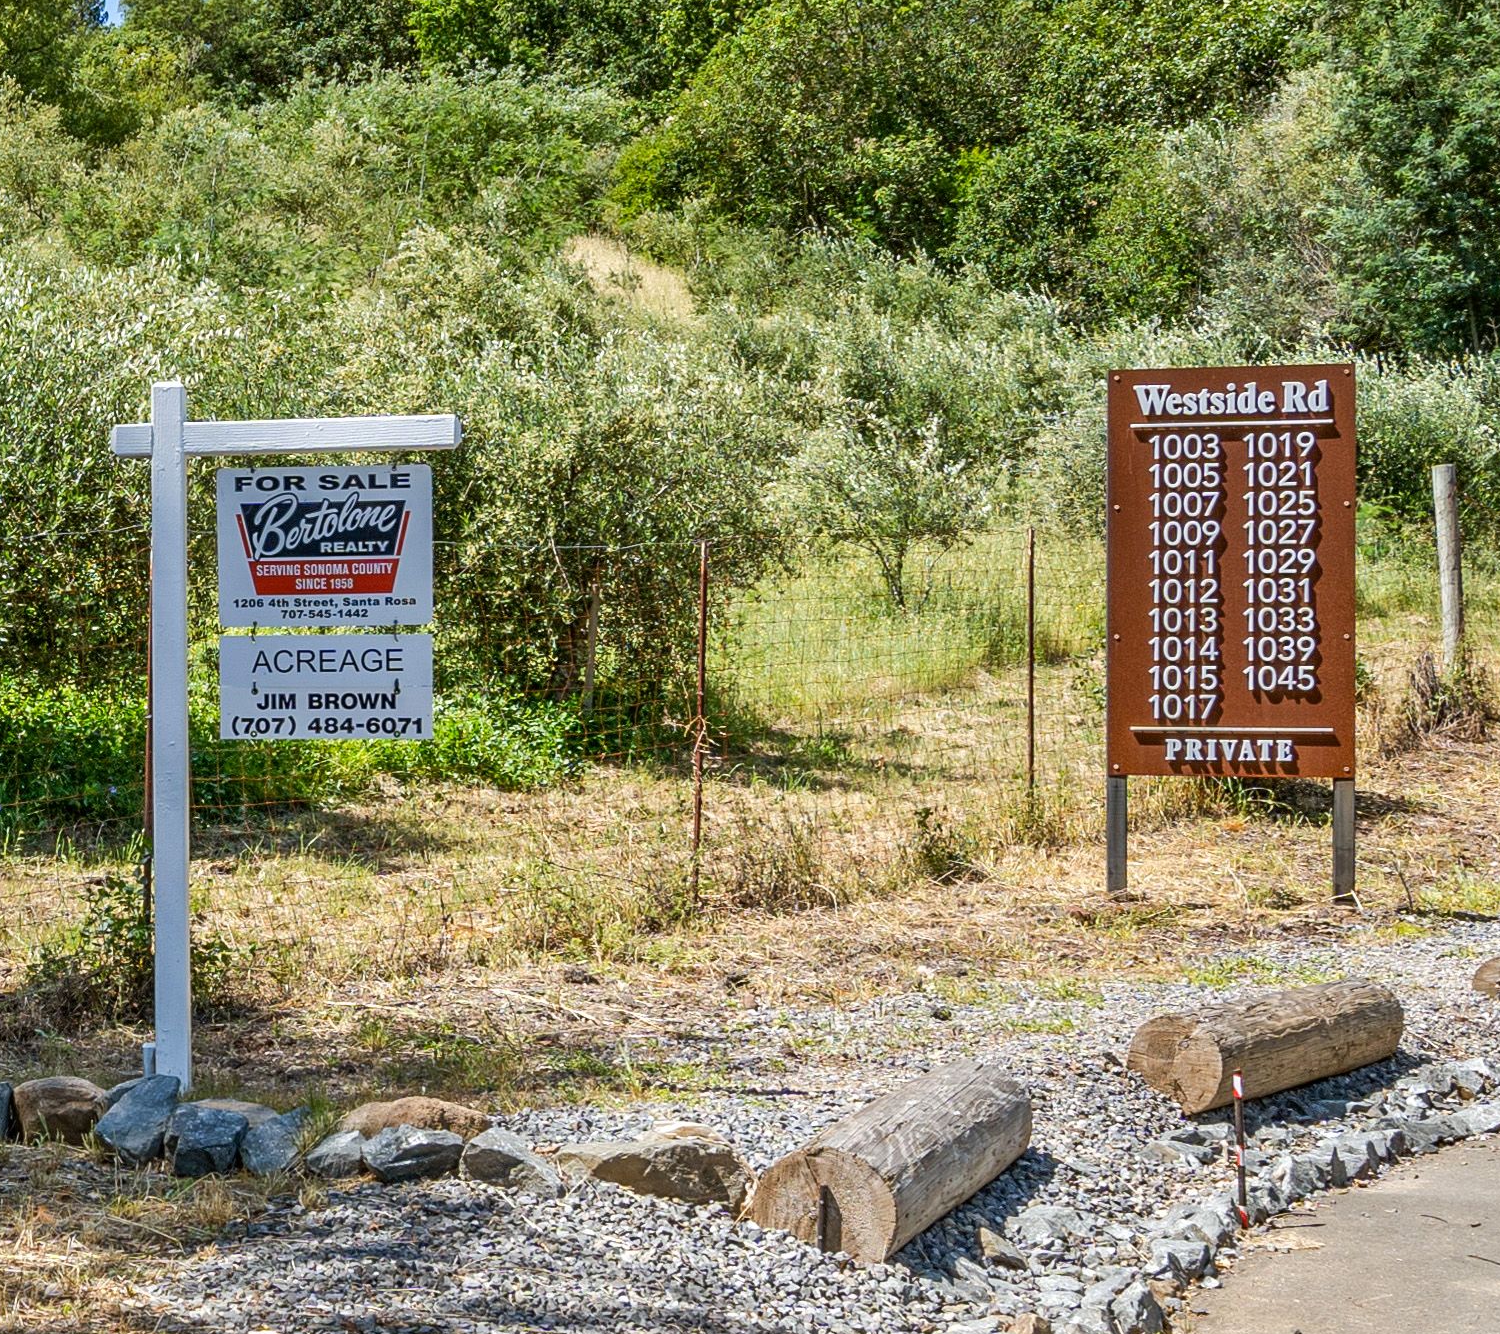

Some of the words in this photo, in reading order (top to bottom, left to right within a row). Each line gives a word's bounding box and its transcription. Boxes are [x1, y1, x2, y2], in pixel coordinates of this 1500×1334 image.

[1132, 381, 1276, 416] Westside
[1281, 379, 1330, 413] Rd
[1148, 434, 1220, 460] 1003
[1242, 432, 1316, 458] 1019
[234, 475, 306, 492] FOR
[318, 473, 411, 490] SALE
[1148, 463, 1220, 489] 1005
[1242, 461, 1313, 487] 1021
[1148, 492, 1220, 517] 1007
[1242, 491, 1316, 516] 1025
[251, 491, 398, 561] Bertolone
[1148, 520, 1220, 546] 1009
[1242, 520, 1316, 545] 1027
[319, 541, 389, 553] REALTY
[256, 564, 301, 577] SERVING
[303, 563, 349, 576] SONOMA
[352, 562, 393, 575] COUNTY
[1148, 549, 1215, 575] 1011
[1242, 548, 1316, 574] 1029
[295, 578, 327, 590] SINCE
[330, 578, 354, 589] 1958
[1148, 578, 1218, 604] 1012
[1242, 578, 1311, 603] 1031
[233, 599, 264, 608] 1206
[268, 598, 289, 608] 4th
[293, 598, 338, 609] Street,
[342, 597, 380, 607] Santa
[385, 596, 416, 606] Rosa
[281, 609, 369, 619] 707-545-1442
[1148, 607, 1218, 633] 1013
[1242, 607, 1315, 633] 1033
[252, 648, 404, 674] ACREAGE
[1148, 636, 1219, 662] 1014
[1242, 636, 1315, 661] 1039
[1148, 665, 1218, 691] 1015
[1242, 665, 1315, 691] 1045
[256, 693, 297, 710] JIM
[308, 693, 397, 710] BROWN
[1148, 694, 1216, 720] 1017
[231, 716, 297, 736] (707)
[307, 717, 422, 734] 484-6071
[1164, 738, 1293, 762] PRIVATE
